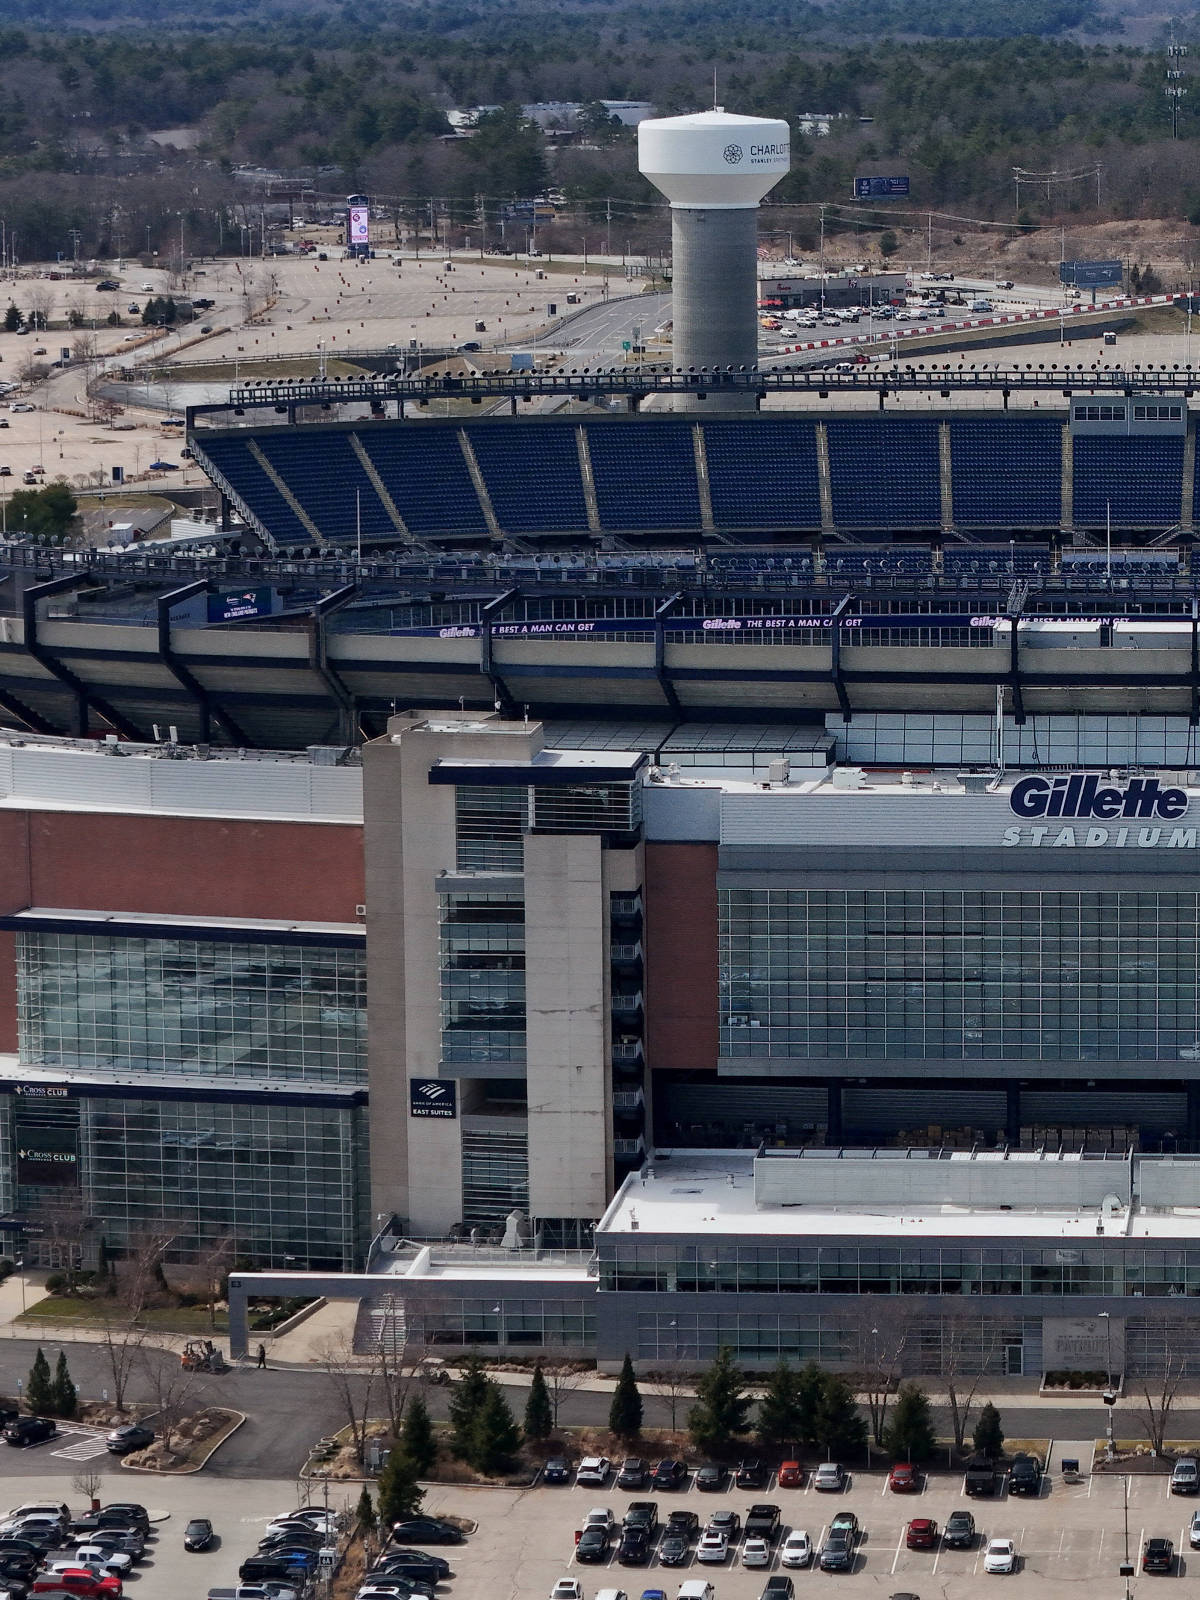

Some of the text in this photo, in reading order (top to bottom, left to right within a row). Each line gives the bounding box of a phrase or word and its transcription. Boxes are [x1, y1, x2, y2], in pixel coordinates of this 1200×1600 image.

[702, 618, 741, 629] Gillette
[746, 620, 763, 628] THE
[765, 620, 786, 628] BEST
[788, 619, 795, 627] A
[798, 619, 820, 627] MAN
[845, 619, 862, 627] GET
[439, 626, 475, 638] Gillette
[499, 625, 519, 634] BEST
[521, 625, 528, 633] A
[531, 624, 553, 633] MAN
[555, 623, 575, 632] CAN
[577, 623, 595, 631] GET
[1009, 773, 1189, 820] Gillette
[1001, 826, 1197, 849] STADIUM
[53, 1154, 76, 1162] CLUB
[231, 1280, 242, 1288] E3
